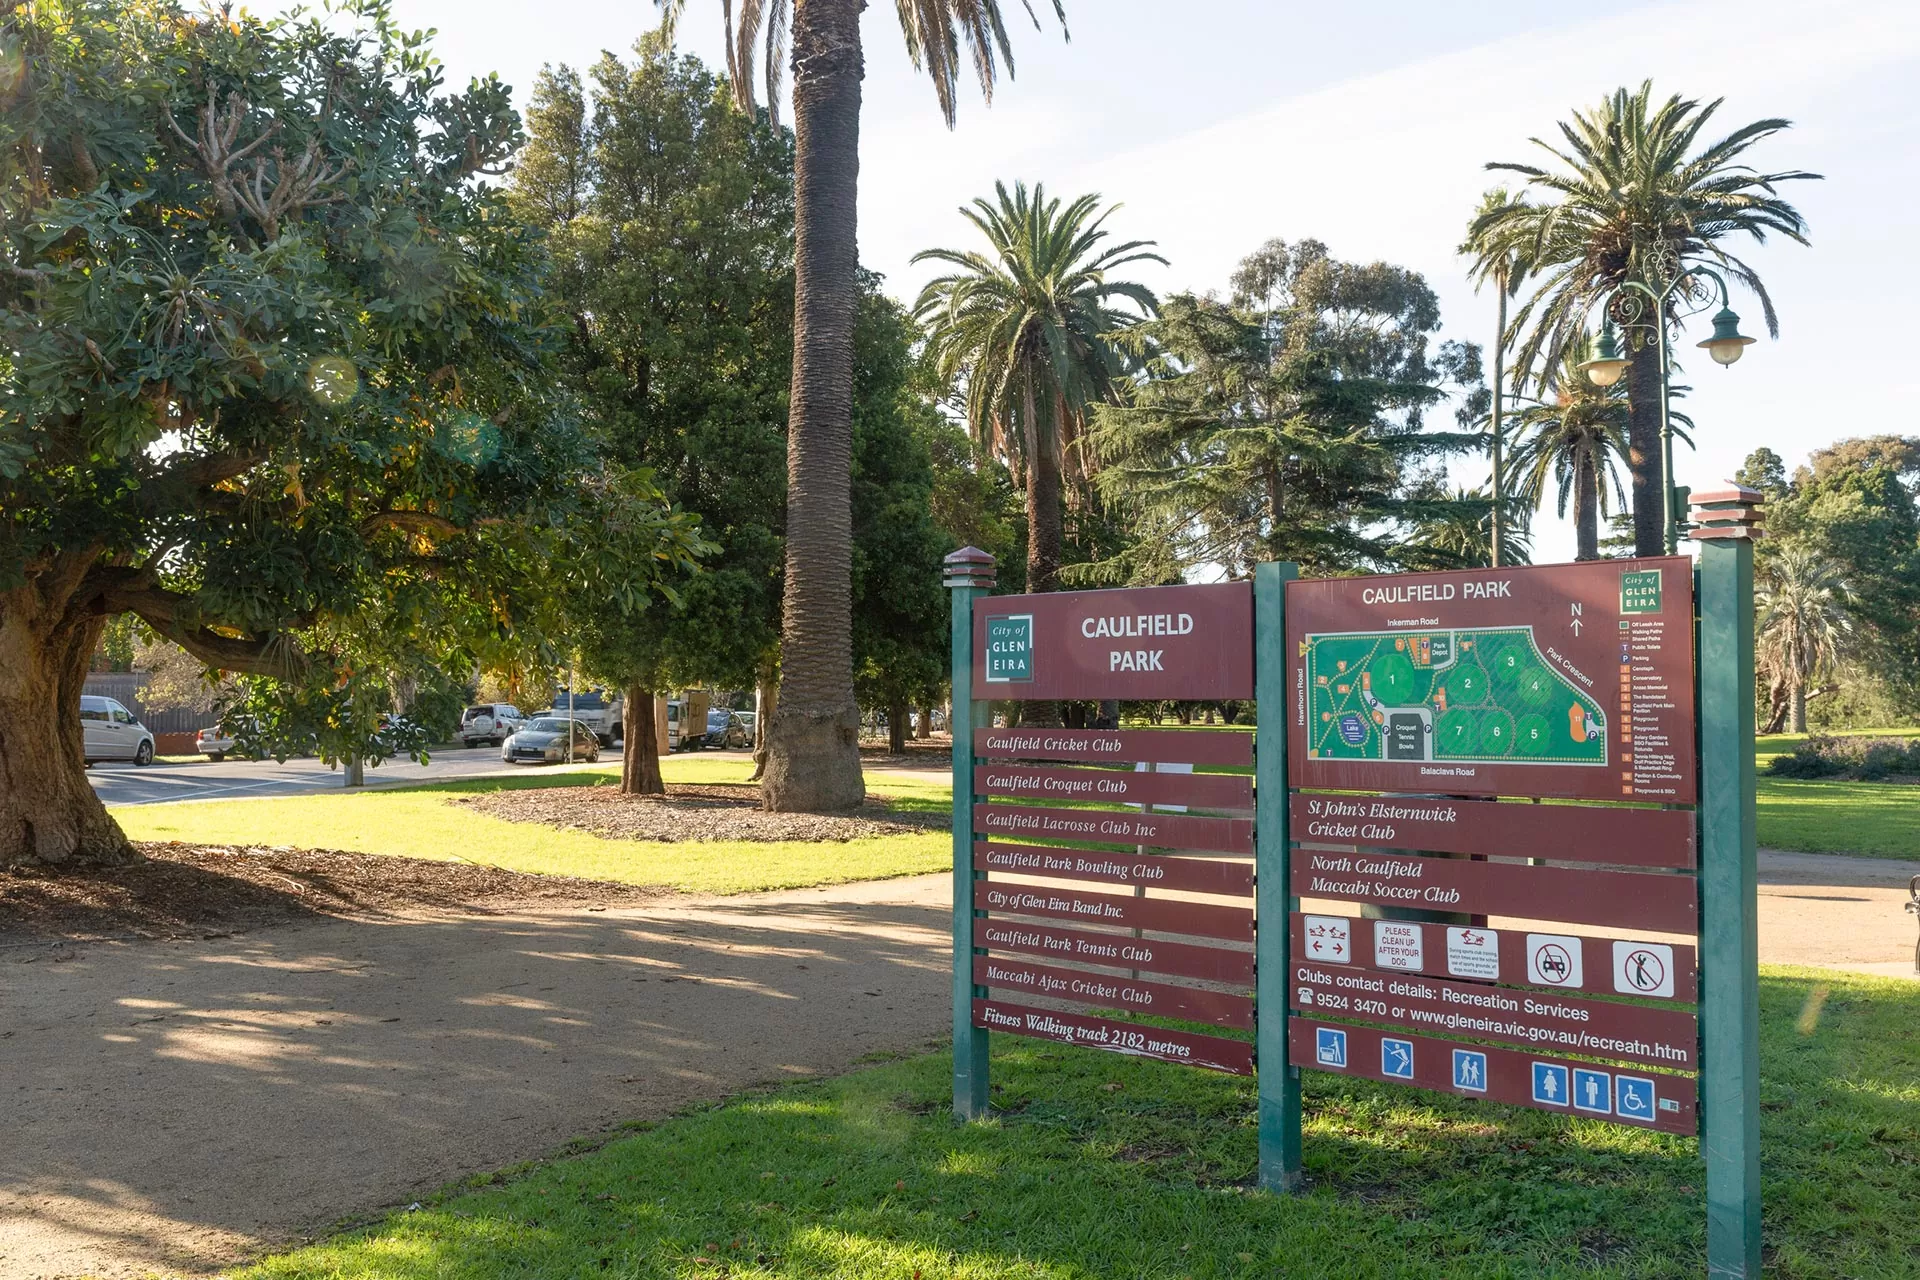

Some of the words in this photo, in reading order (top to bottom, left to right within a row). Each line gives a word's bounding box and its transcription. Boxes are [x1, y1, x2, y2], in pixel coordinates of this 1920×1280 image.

[1647, 576, 1656, 584] of
[1363, 584, 1455, 604] CAULFIELD
[1463, 580, 1511, 598] PARK
[1626, 587, 1656, 595] GLEN
[1626, 599, 1656, 607] EIRA
[1571, 603, 1582, 616] N
[1081, 614, 1193, 638] CAULFIELD
[1388, 618, 1419, 626] Inkerman
[1420, 617, 1439, 625] Road
[993, 625, 1011, 636] City
[1015, 625, 1025, 635] of
[993, 641, 1025, 652] GLEN
[994, 659, 1025, 670] EIRA
[1110, 650, 1164, 672] PARK
[1508, 657, 1514, 666] 3
[1547, 647, 1562, 663] Park
[1563, 660, 1594, 688] Crescent
[1390, 675, 1394, 685] 1
[1465, 679, 1471, 688] 2
[1532, 681, 1538, 690] 4
[1456, 726, 1463, 735] 7
[1494, 727, 1500, 736] 6
[1531, 729, 1537, 739] 5
[987, 736, 1039, 753] Caulfield
[1044, 738, 1088, 752] Cricket
[1092, 739, 1122, 752] Club
[1421, 766, 1454, 776] Balaclava
[1455, 767, 1474, 776] Road
[987, 775, 1039, 791] Caulfield
[1044, 777, 1092, 794] Croquet
[1097, 780, 1127, 793] Club
[1308, 800, 1320, 814] St
[1322, 802, 1366, 818] John's
[1368, 804, 1456, 822] Elsternwick
[986, 813, 1038, 829] Caulfield
[1042, 817, 1095, 832] Lacrosse
[1101, 820, 1130, 836] Club
[1135, 823, 1156, 837] Inc
[1308, 822, 1357, 838] Cricket
[1361, 825, 1395, 840] Club
[986, 851, 1039, 868] Caulfield
[1044, 856, 1072, 871] Park
[1076, 859, 1128, 879] Bowling
[1133, 864, 1163, 880] Club
[1310, 856, 1351, 872] North
[1355, 859, 1422, 879] Caulfield
[1310, 877, 1370, 895] Maccabi
[1373, 883, 1421, 900] Soccer
[1424, 886, 1460, 903] Club
[988, 890, 1007, 906] City
[1010, 893, 1022, 909] of
[1022, 895, 1045, 909] Glen
[1048, 897, 1070, 911] Eira
[1072, 900, 1101, 915] Band
[1104, 904, 1124, 918] Inc.
[1385, 927, 1411, 936] PLEASE
[986, 928, 1039, 946] Caulfield
[1043, 935, 1071, 950] Park
[1076, 940, 1117, 957] Tennis
[1122, 946, 1152, 962] Club
[1382, 937, 1404, 945] CLEAN
[1379, 947, 1399, 955] AFTER
[1401, 948, 1419, 957] YOUR
[1392, 958, 1406, 966] DOG
[986, 966, 1035, 984] Maccabi
[1039, 975, 1067, 990] Ajax
[1071, 979, 1116, 999] Cricket
[1122, 988, 1152, 1004] Club
[1297, 968, 1332, 985] Clubs
[1336, 974, 1384, 993] contact
[1389, 981, 1437, 1000] details:
[1442, 988, 1518, 1011] Recreation
[1524, 999, 1589, 1021] Services
[984, 1007, 1021, 1027] Fitness
[1025, 1014, 1073, 1040] Walking
[1077, 1024, 1108, 1042] track
[1111, 1030, 1144, 1048] 2182
[1148, 1038, 1190, 1056] metres
[1317, 993, 1349, 1010] 9524
[1354, 998, 1387, 1015] 3470
[1391, 1006, 1405, 1018] or
[1410, 1010, 1687, 1061] www.gleneira.vic.gov.au/recreatn.htm
